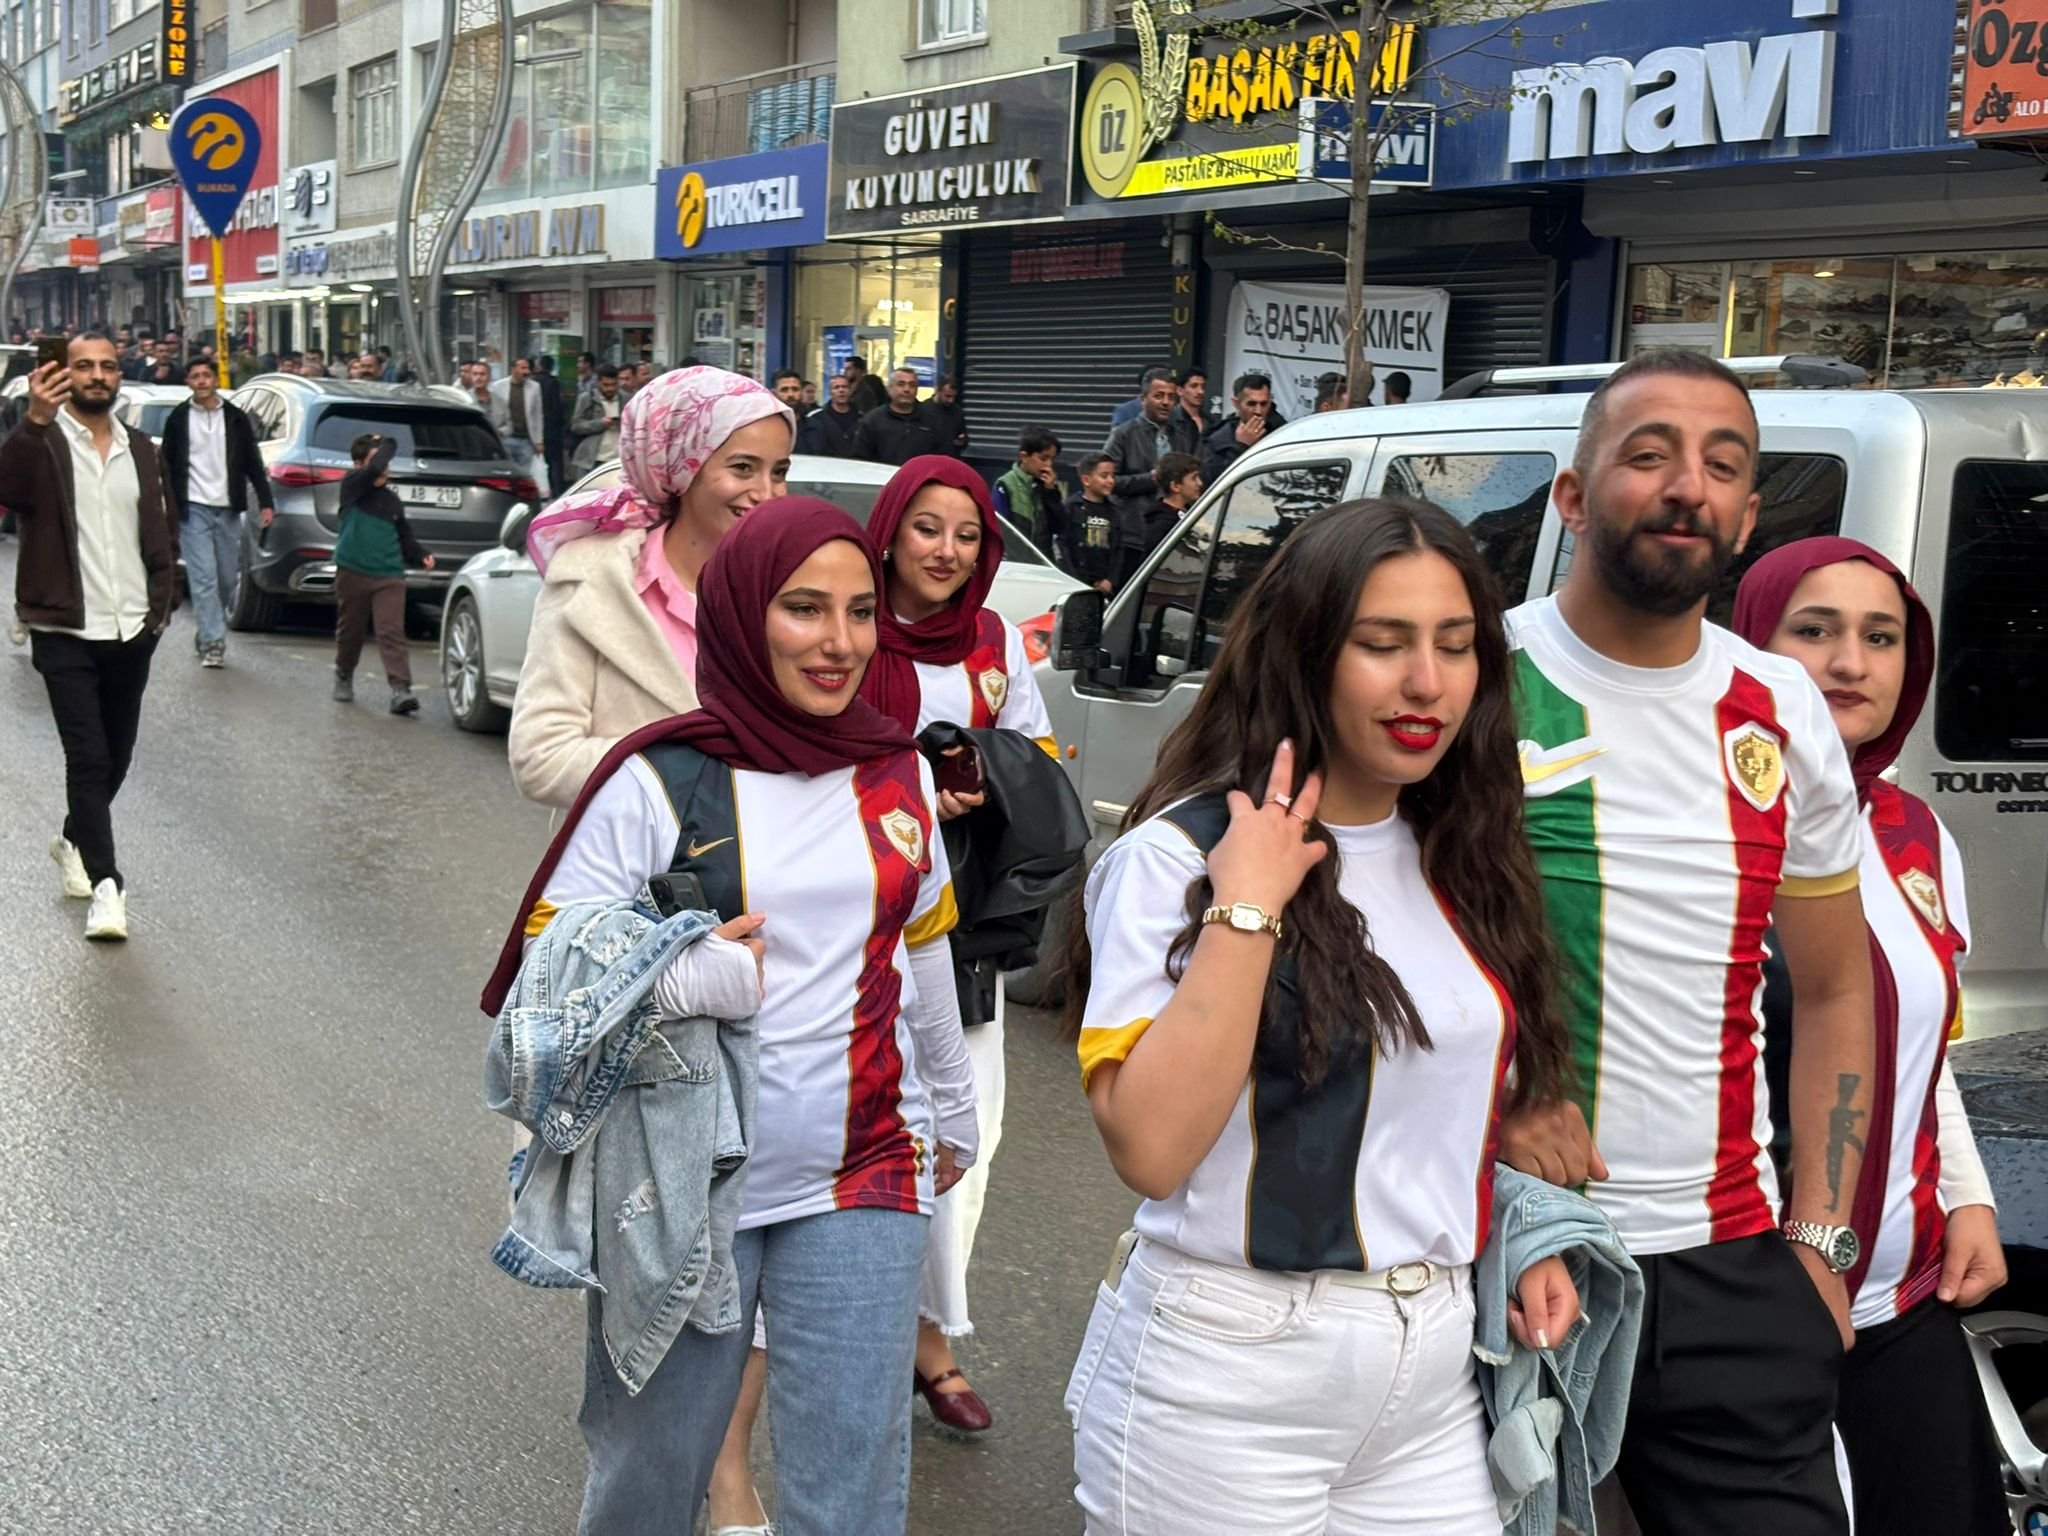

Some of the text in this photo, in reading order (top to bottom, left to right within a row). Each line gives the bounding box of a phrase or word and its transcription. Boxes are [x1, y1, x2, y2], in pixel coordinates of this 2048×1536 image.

[1185, 40, 1298, 125] BAŞAK
[1508, 0, 1837, 163] mavi
[884, 98, 992, 156] GÜVEN
[1100, 103, 1127, 154] ÖZ
[2014, 99, 2041, 117] ALO
[846, 158, 1037, 211] KUYUMCULUK
[1164, 160, 1213, 184] PASTANE
[705, 175, 804, 228] TURKCELL
[901, 204, 980, 226] SARRAFİYE
[548, 204, 606, 256] AVM
[1265, 302, 1340, 353] BAŞAK
[1363, 308, 1433, 352] KMEK
